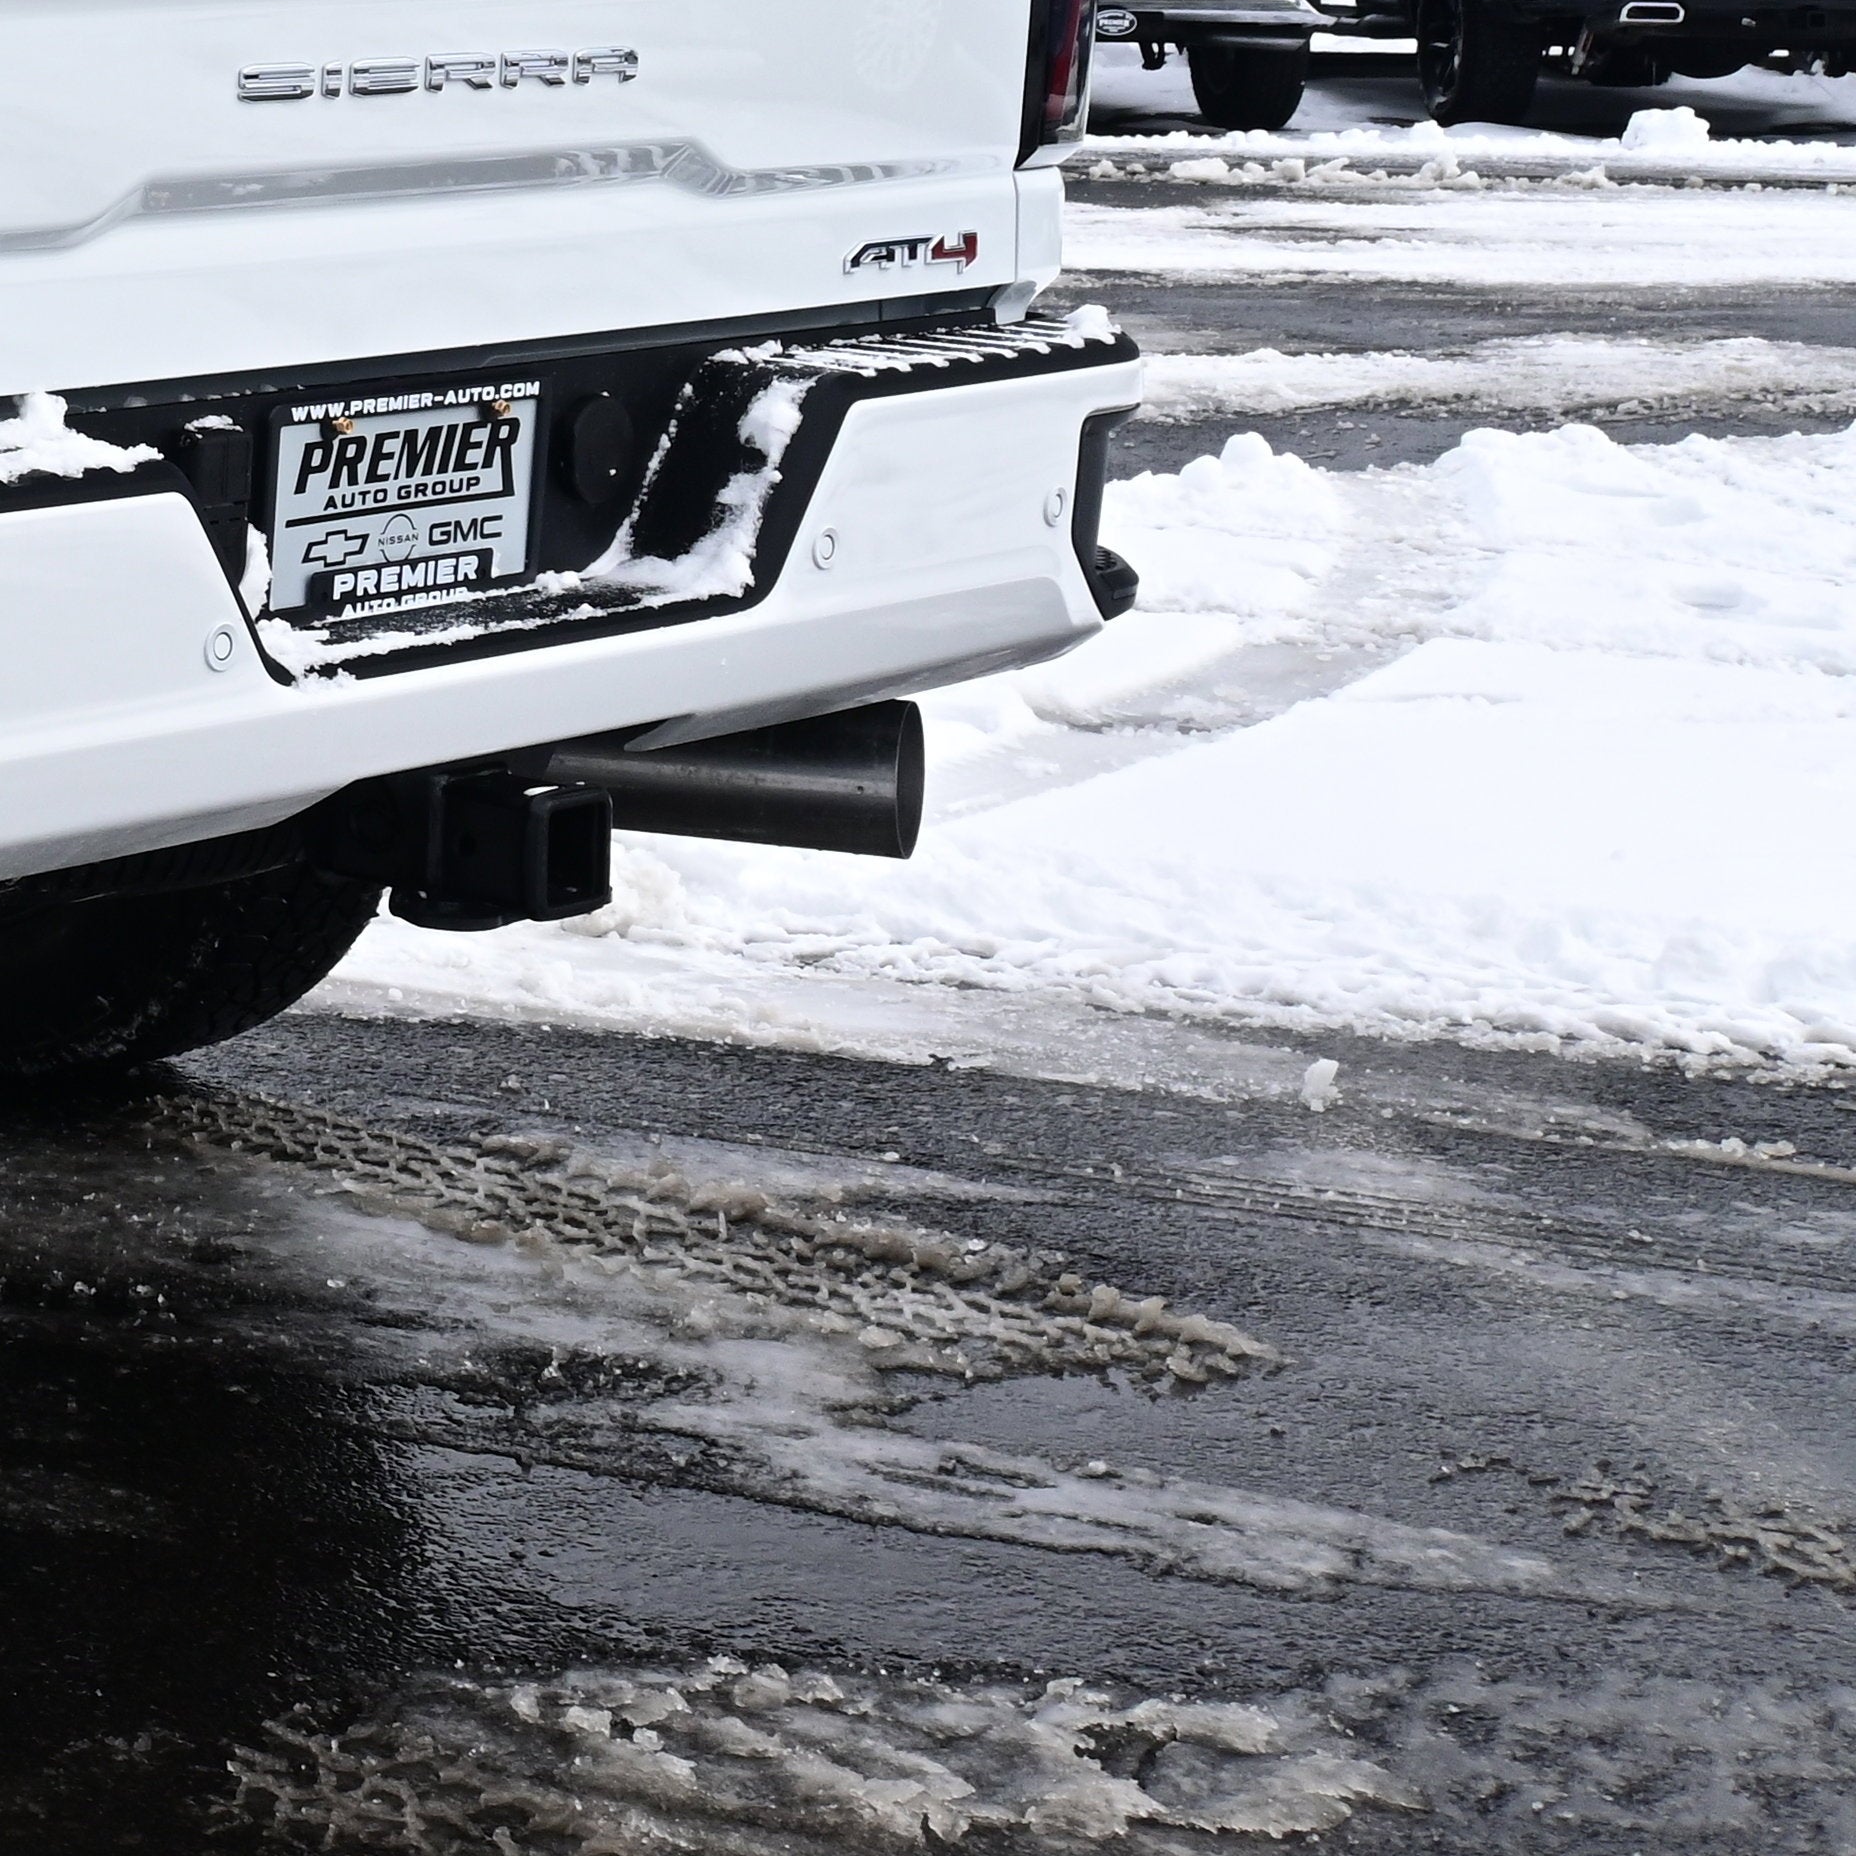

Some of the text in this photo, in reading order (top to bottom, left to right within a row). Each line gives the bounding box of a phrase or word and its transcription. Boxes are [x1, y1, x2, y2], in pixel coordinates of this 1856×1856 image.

[237, 46, 639, 103] SIERRA
[843, 230, 978, 275] AT4
[291, 381, 540, 422] WWW.PREMIER-AUTO.COM
[294, 417, 520, 495] PREMIER
[323, 476, 481, 511] AUTO GROUP
[378, 515, 503, 546] NISSAN GMC
[333, 555, 479, 600] PREMIER
[341, 597, 396, 619] AUTO
